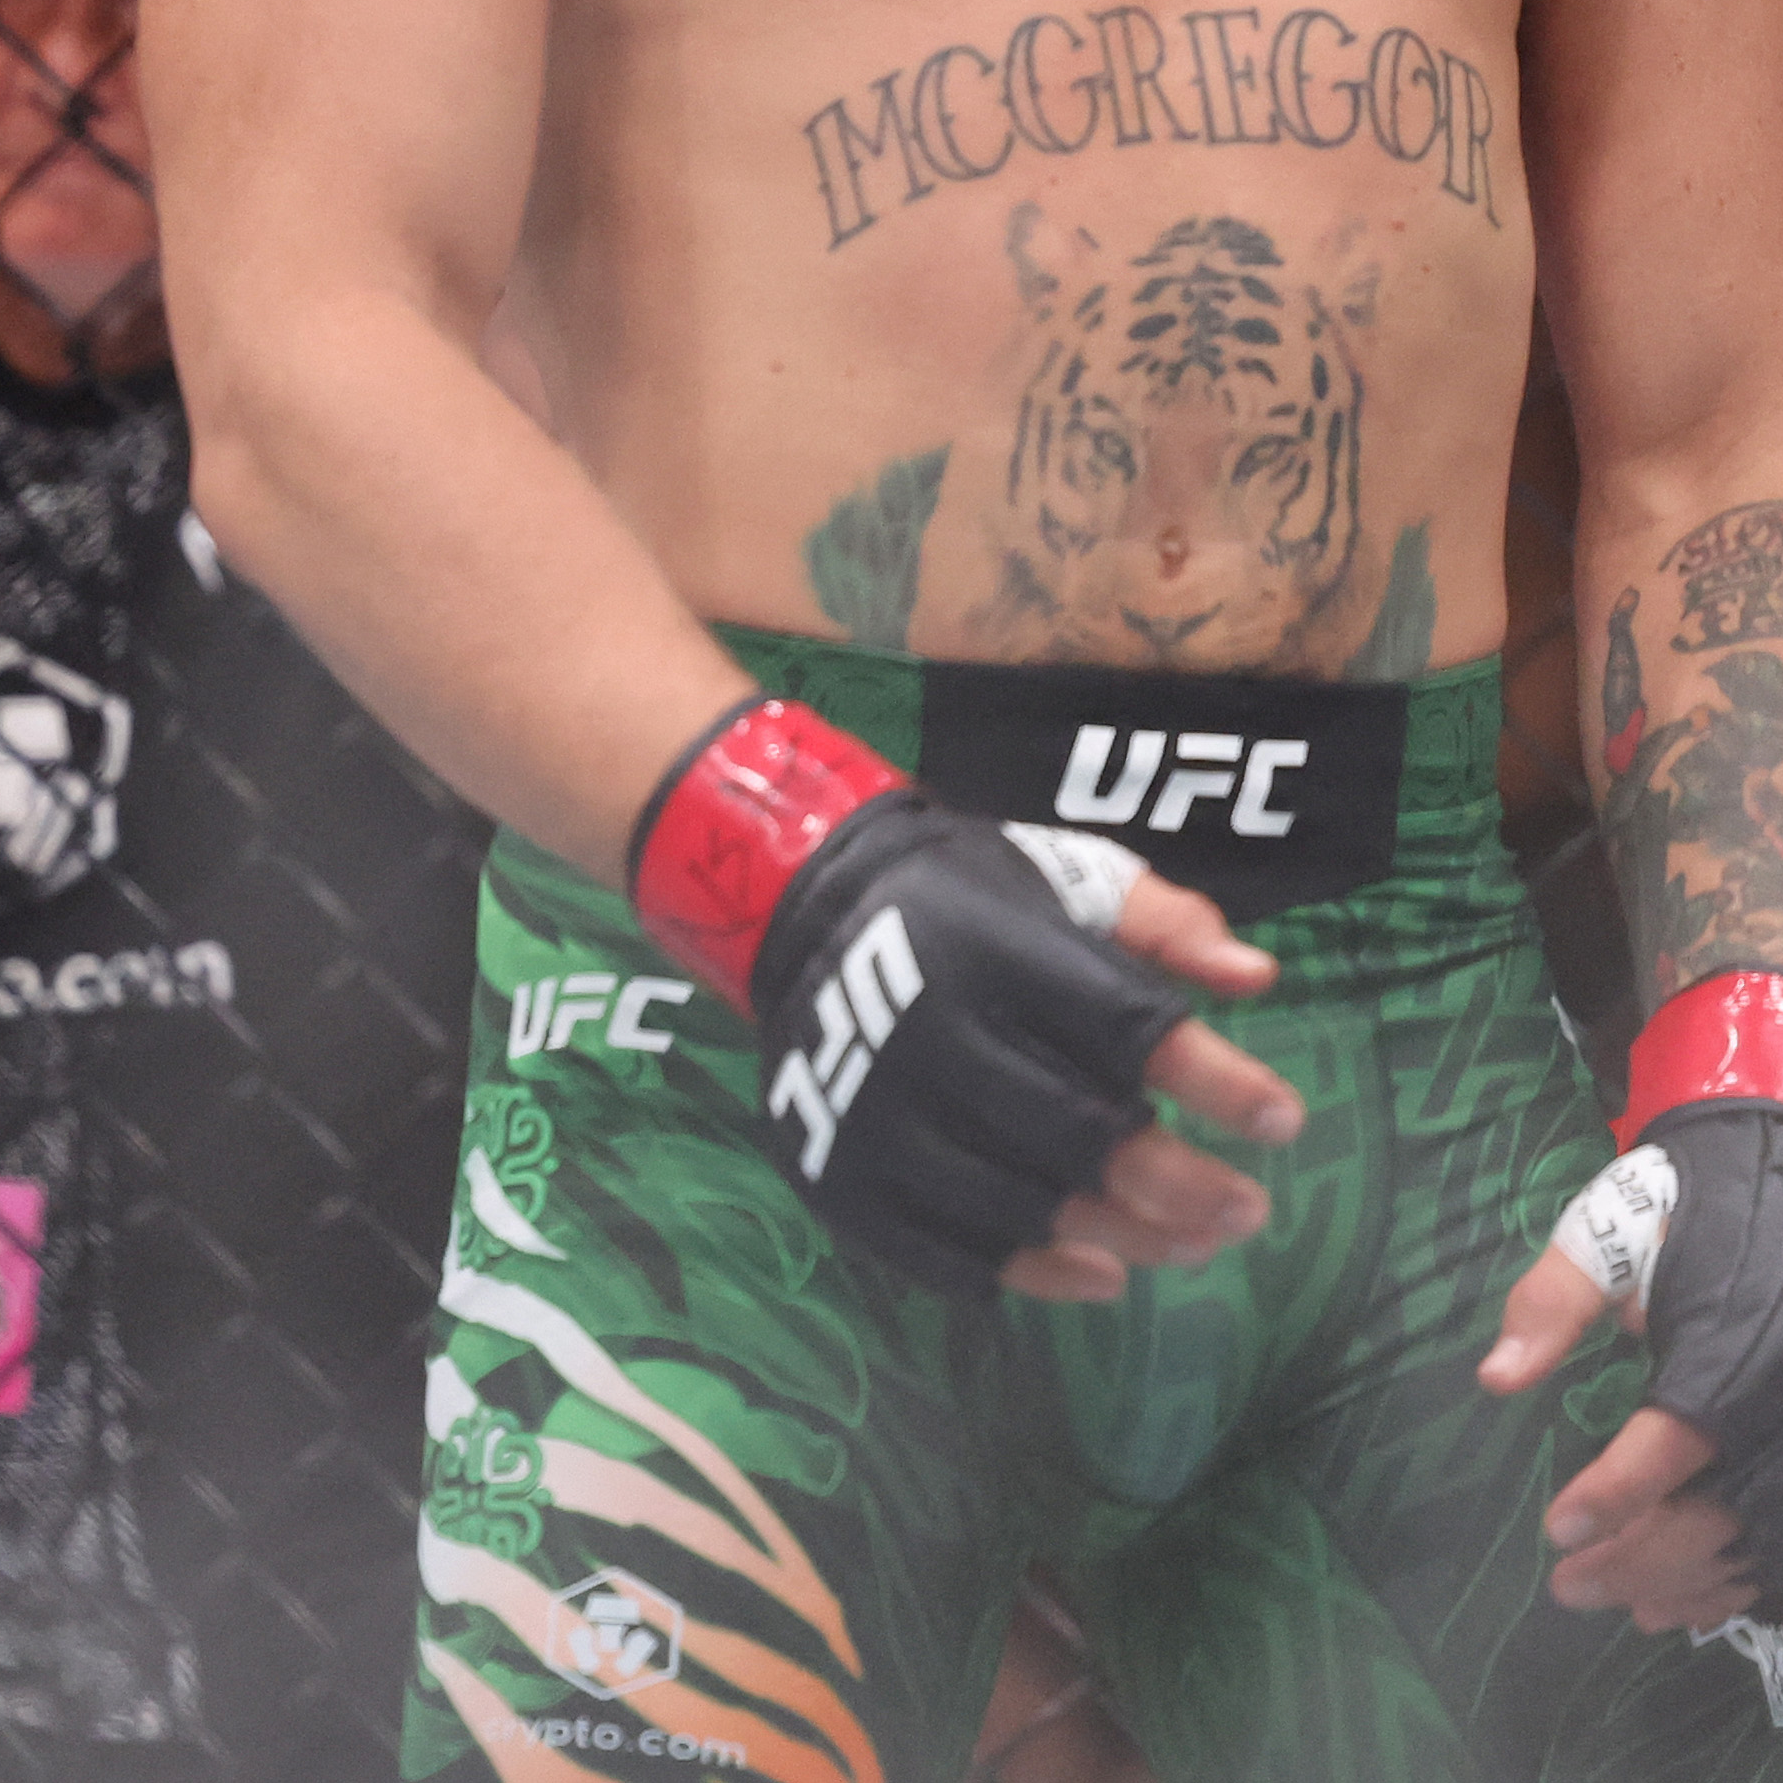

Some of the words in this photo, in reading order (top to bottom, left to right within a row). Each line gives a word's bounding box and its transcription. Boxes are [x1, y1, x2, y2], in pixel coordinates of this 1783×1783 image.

[804, 5, 1502, 252] MCGREGOR
[1054, 722, 1310, 837] UFC
[507, 971, 696, 1060] UFC
[769, 903, 926, 1184] UFC
